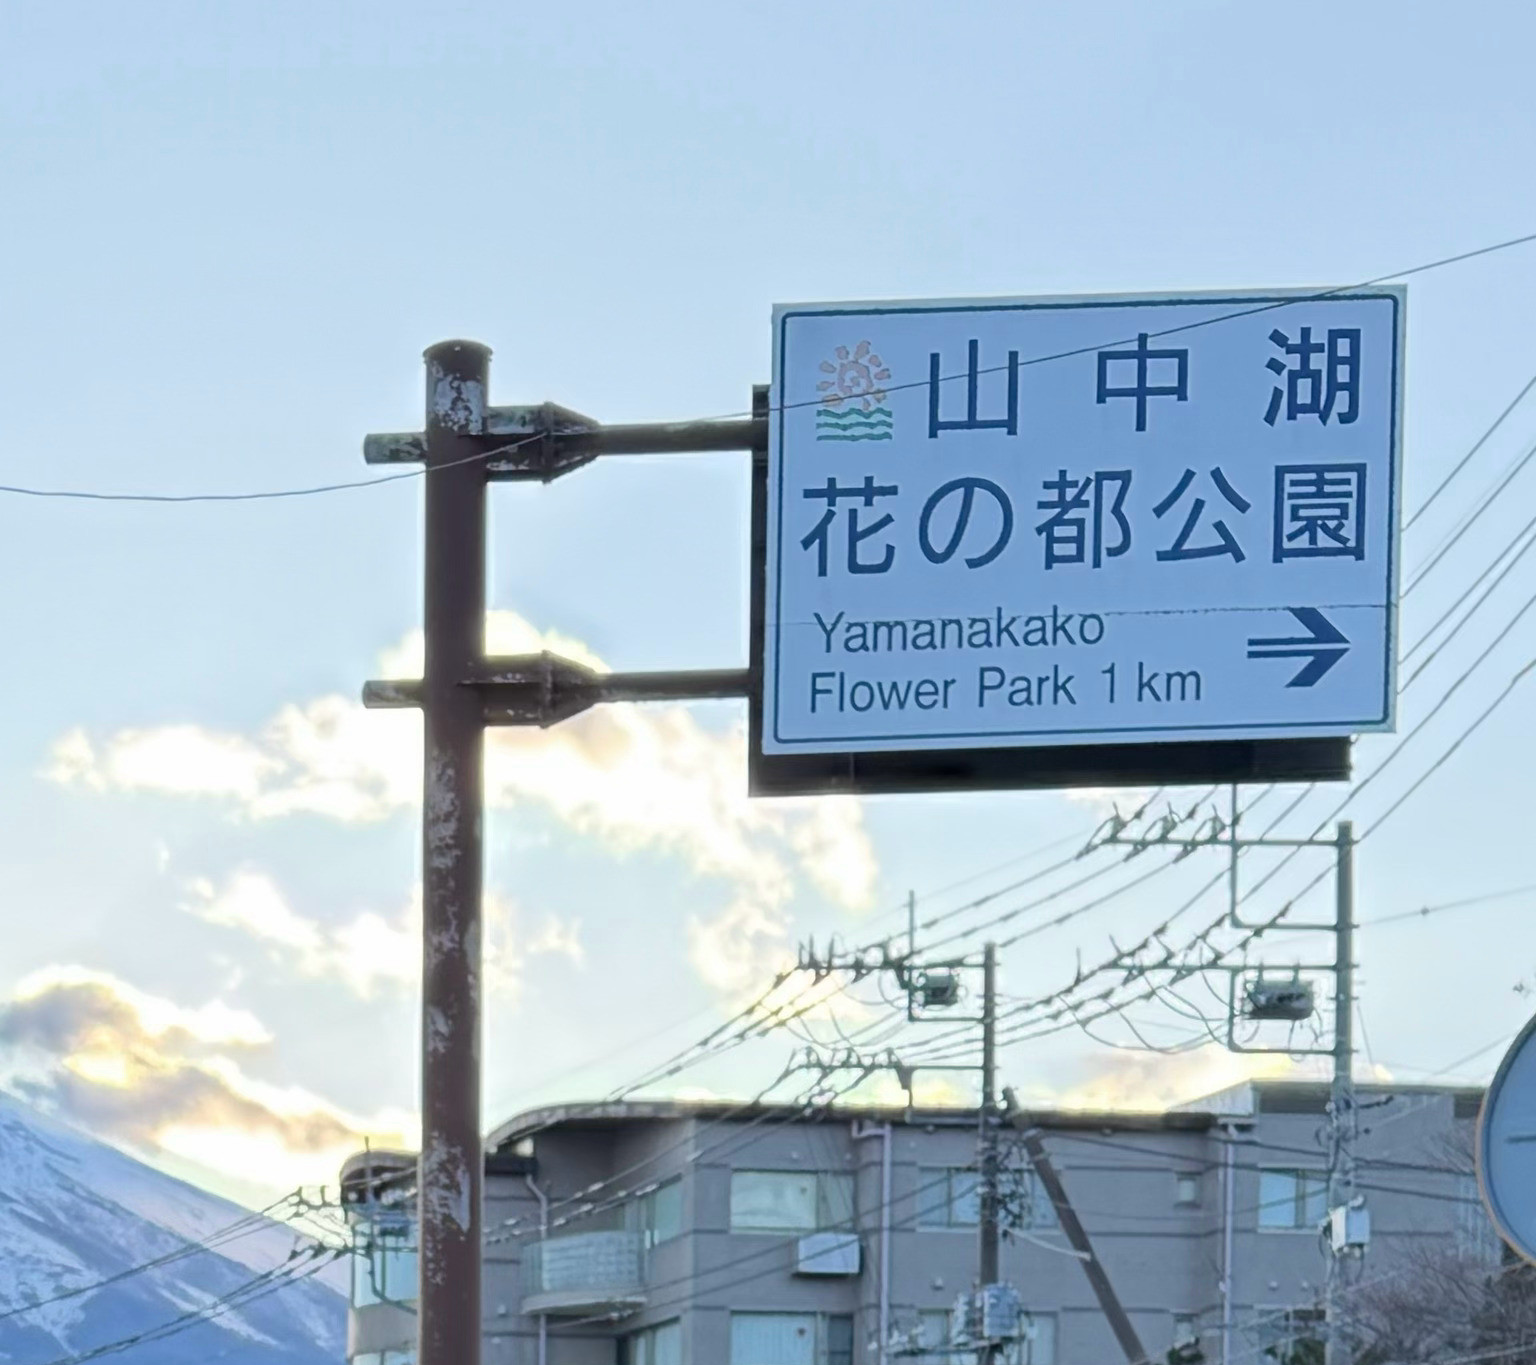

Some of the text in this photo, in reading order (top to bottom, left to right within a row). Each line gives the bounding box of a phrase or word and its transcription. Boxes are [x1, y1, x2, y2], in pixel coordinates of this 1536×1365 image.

[928, 326, 1362, 439] 山中湖
[800, 462, 1367, 578] 花の都公園
[813, 606, 1105, 654] Yamanakako
[810, 661, 1202, 714] Flower Park 1 km
